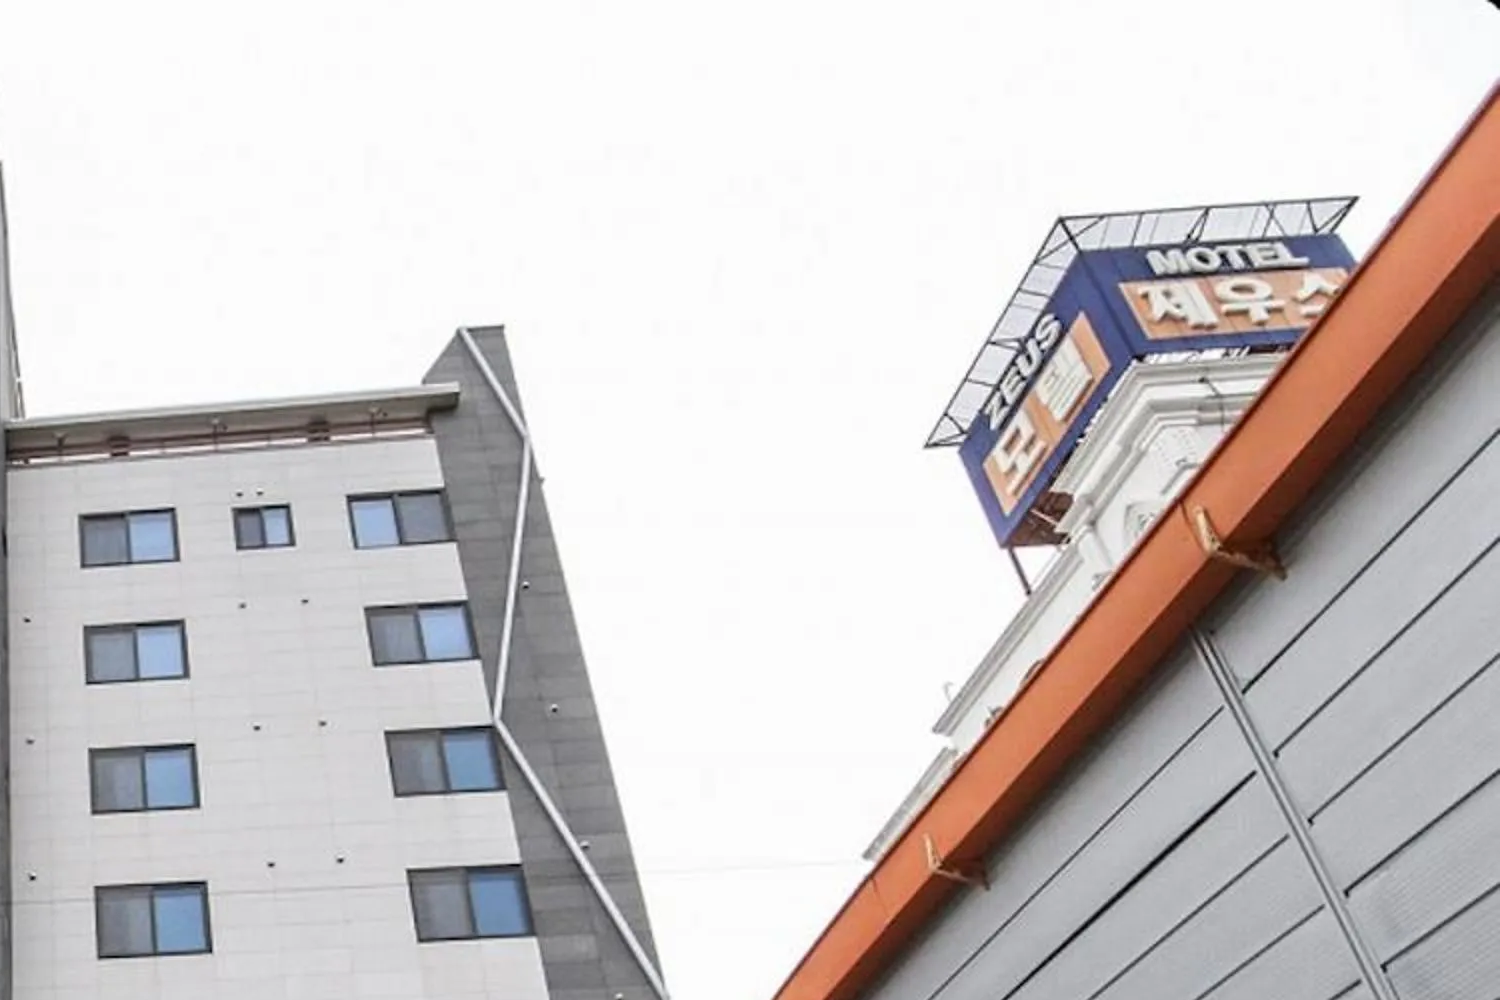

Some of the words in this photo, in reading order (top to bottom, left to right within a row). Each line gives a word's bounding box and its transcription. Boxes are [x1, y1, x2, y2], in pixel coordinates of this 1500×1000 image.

[1146, 242, 1310, 276] MOTEL
[984, 313, 1062, 431] ZEUS
[994, 332, 1093, 498] 모텔
